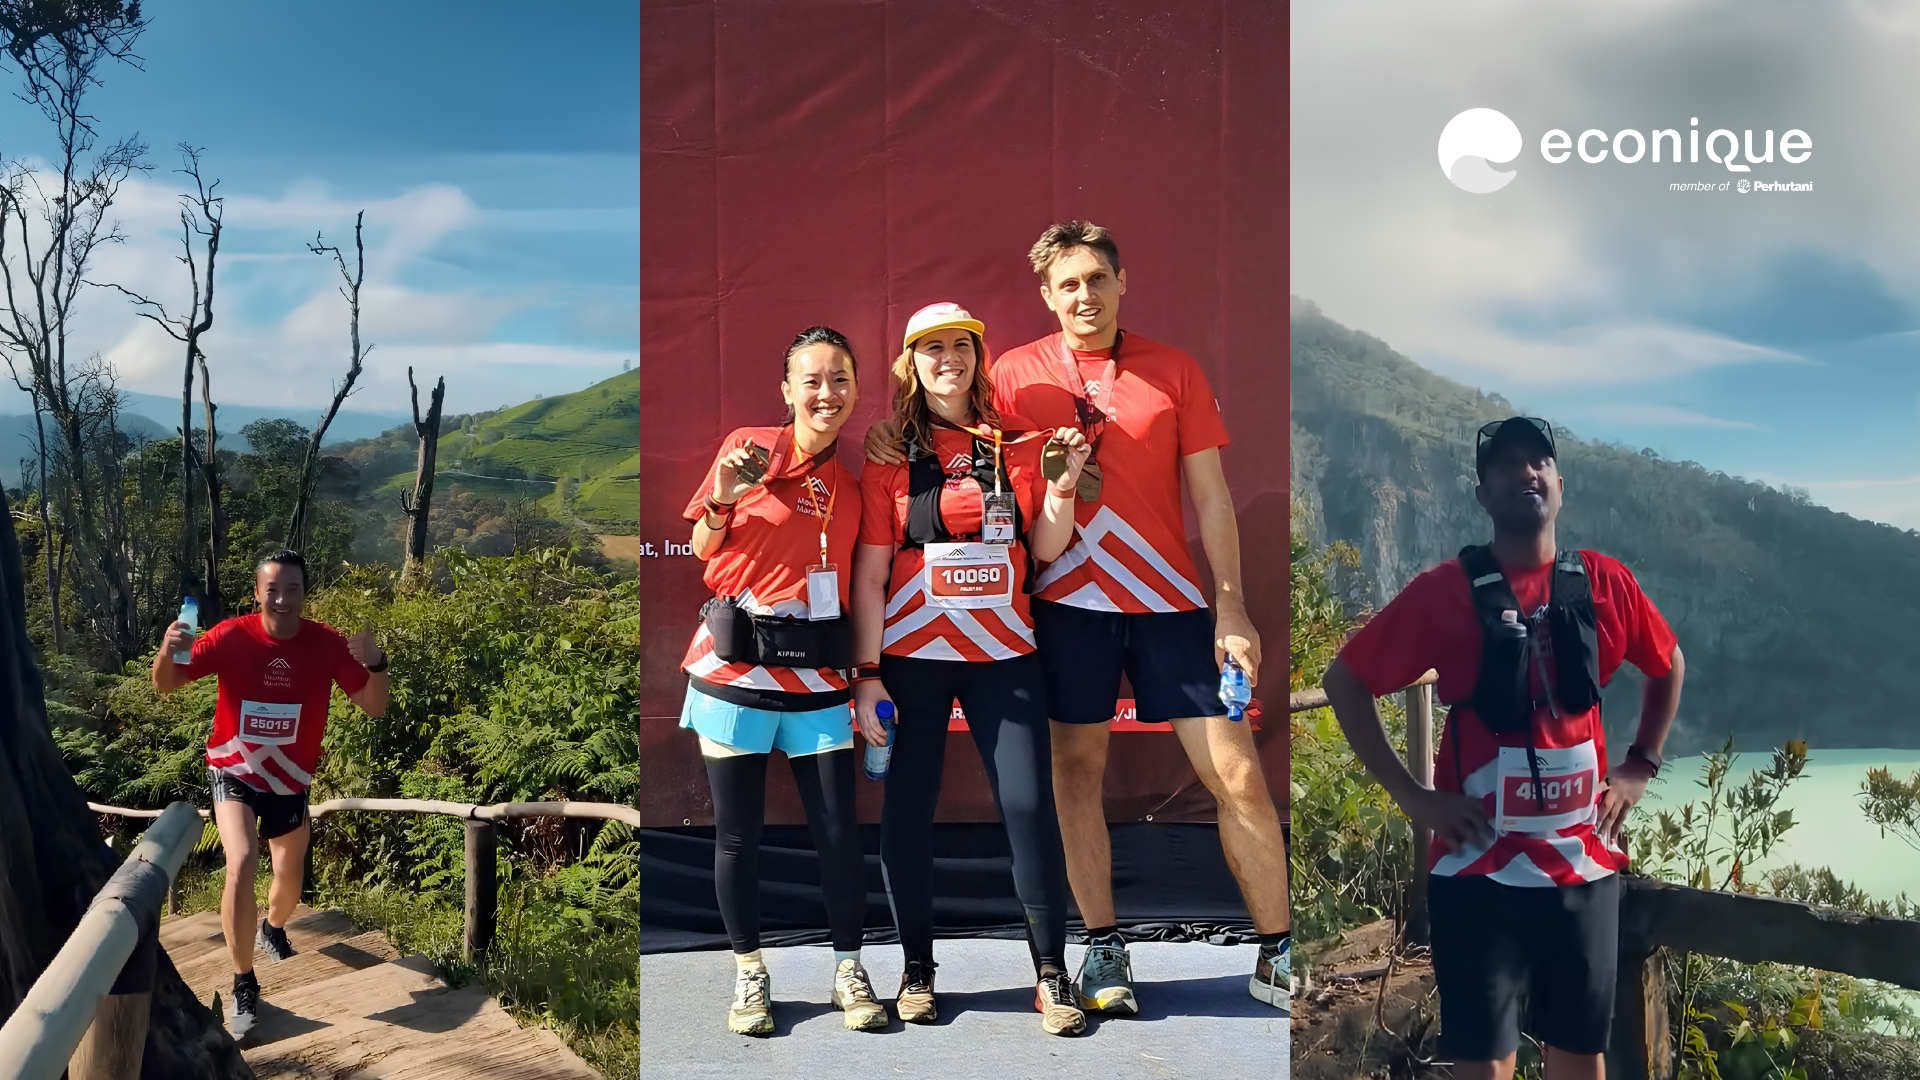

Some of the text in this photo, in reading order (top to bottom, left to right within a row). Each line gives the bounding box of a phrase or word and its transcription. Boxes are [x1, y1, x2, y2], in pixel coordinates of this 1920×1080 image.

[994, 527, 1003, 537] 7
[941, 567, 1001, 584] 10060
[777, 650, 806, 658] KIPRUN
[250, 718, 290, 730] 25015
